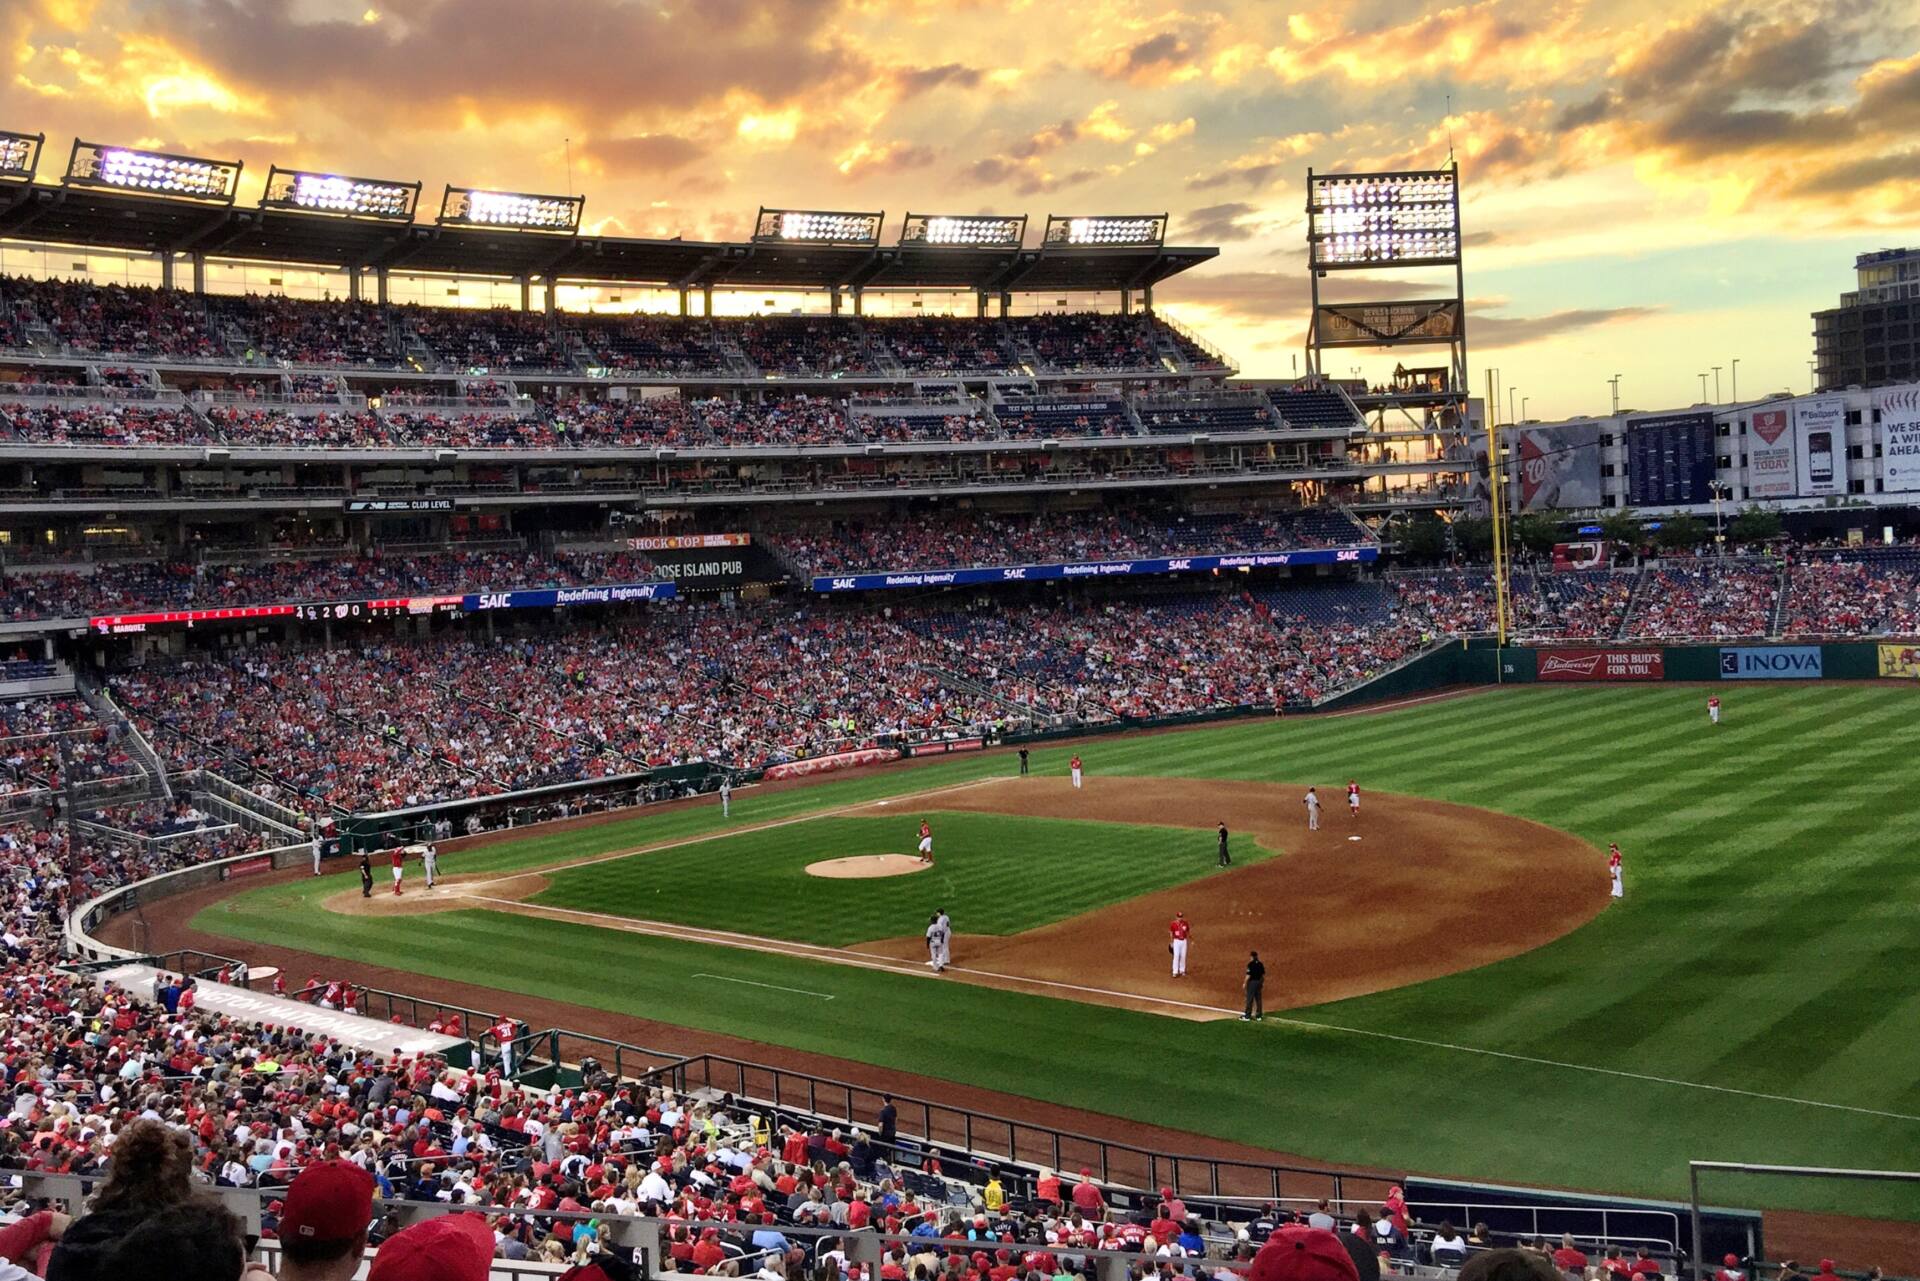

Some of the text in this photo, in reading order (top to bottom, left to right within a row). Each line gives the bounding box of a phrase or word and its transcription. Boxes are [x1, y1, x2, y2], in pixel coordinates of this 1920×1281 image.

[1888, 423, 1906, 433] WE
[1891, 433, 1920, 444] A WI
[1754, 459, 1789, 470] TODAY
[411, 501, 429, 509] CLUB
[431, 500, 451, 509] LEVEL
[627, 536, 700, 550] SHOCK TOP
[1219, 554, 1290, 567] Redefining Ingenuity
[1337, 550, 1359, 561] SAIC
[654, 561, 743, 578] OOSE ISLAND PUB
[1063, 562, 1133, 575] Redefining Ingenuity
[1168, 559, 1191, 570] SAIC
[886, 572, 957, 586] Redefining Ingenuity
[1003, 568, 1026, 579] SAIC
[832, 578, 856, 590] SAIC
[556, 584, 657, 603] Redefining Ingenuity
[478, 594, 511, 609] SAIC
[323, 607, 330, 618] 2
[352, 605, 360, 616] 0
[114, 623, 146, 633] MARQUEZ
[1546, 660, 1597, 669] Budweiser
[1606, 654, 1661, 664] THIS BUD'S
[1745, 654, 1820, 671] INOVA
[1607, 665, 1652, 675] FOR YOU.
[266, 1006, 395, 1042] NATIONALS
[501, 1026, 512, 1038] 31
